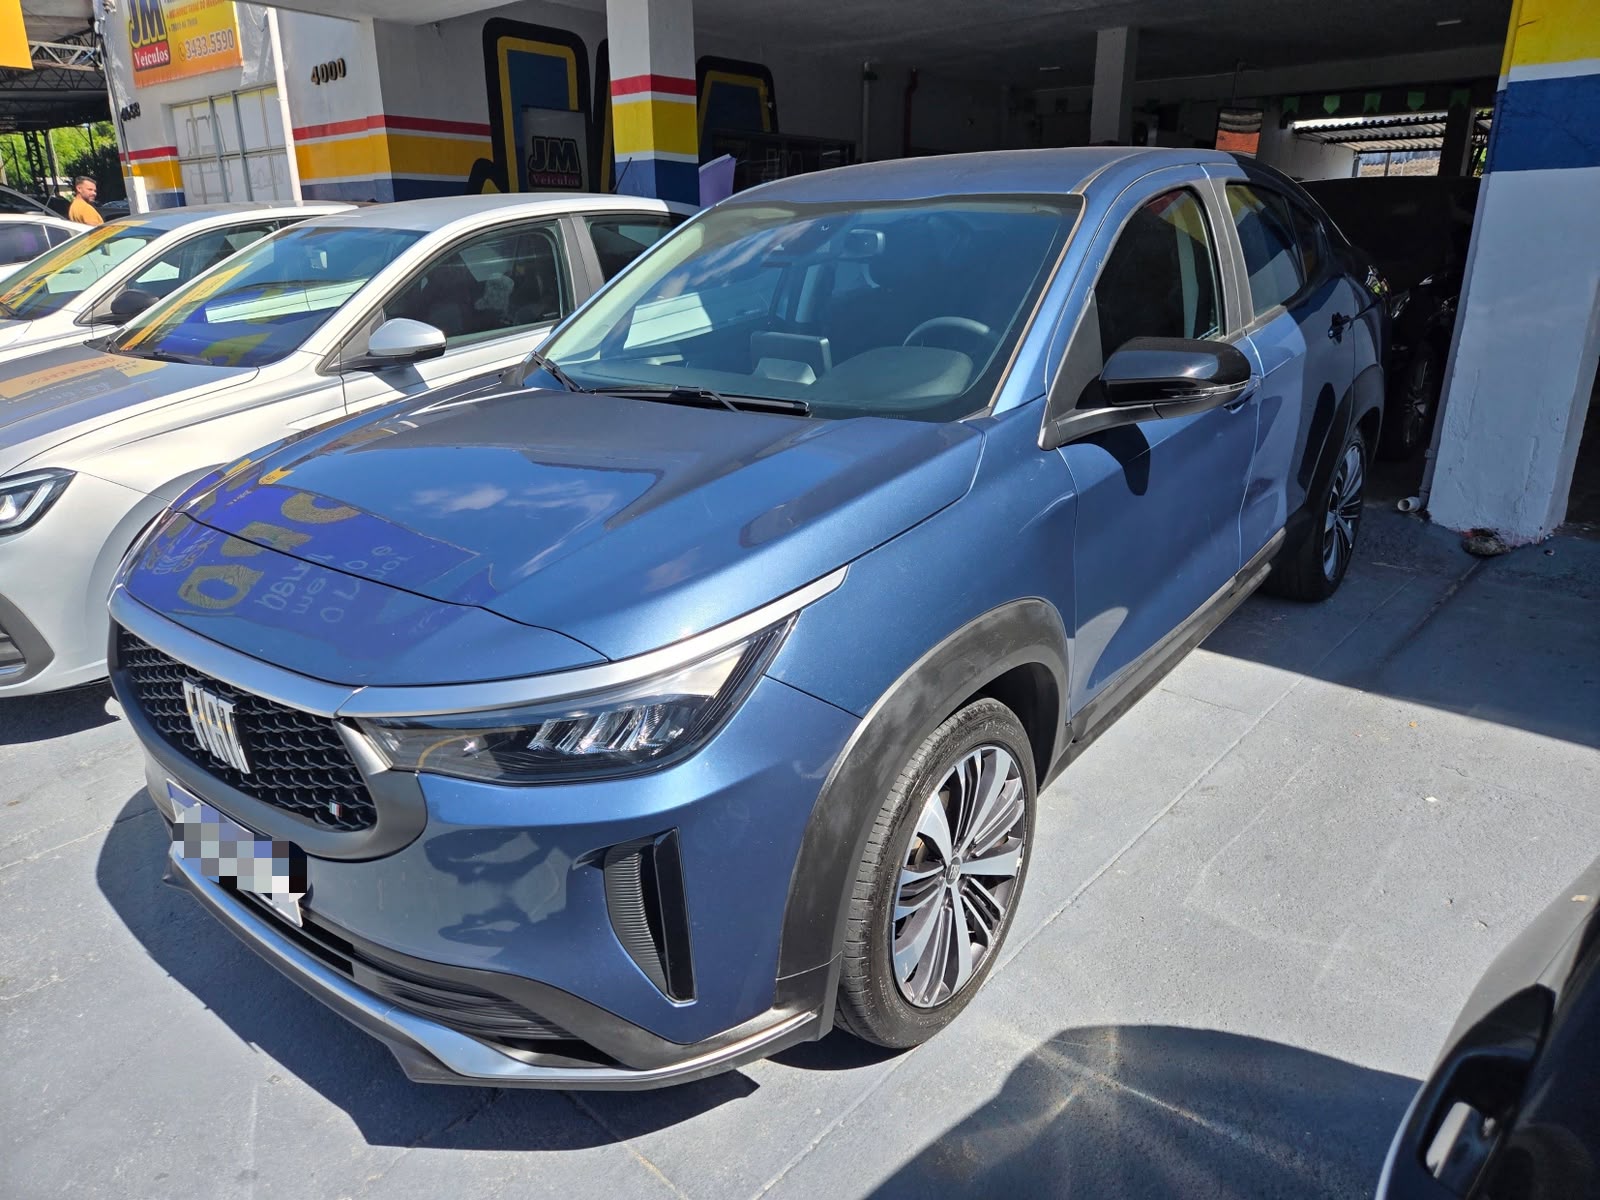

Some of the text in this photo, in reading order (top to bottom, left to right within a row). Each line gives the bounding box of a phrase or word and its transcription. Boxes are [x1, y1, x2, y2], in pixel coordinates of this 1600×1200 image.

[129, 0, 168, 48] JM
[184, 28, 234, 60] 3433.5590
[311, 57, 346, 85] 4000
[528, 136, 581, 173] JM
[183, 679, 251, 775] FIAT
